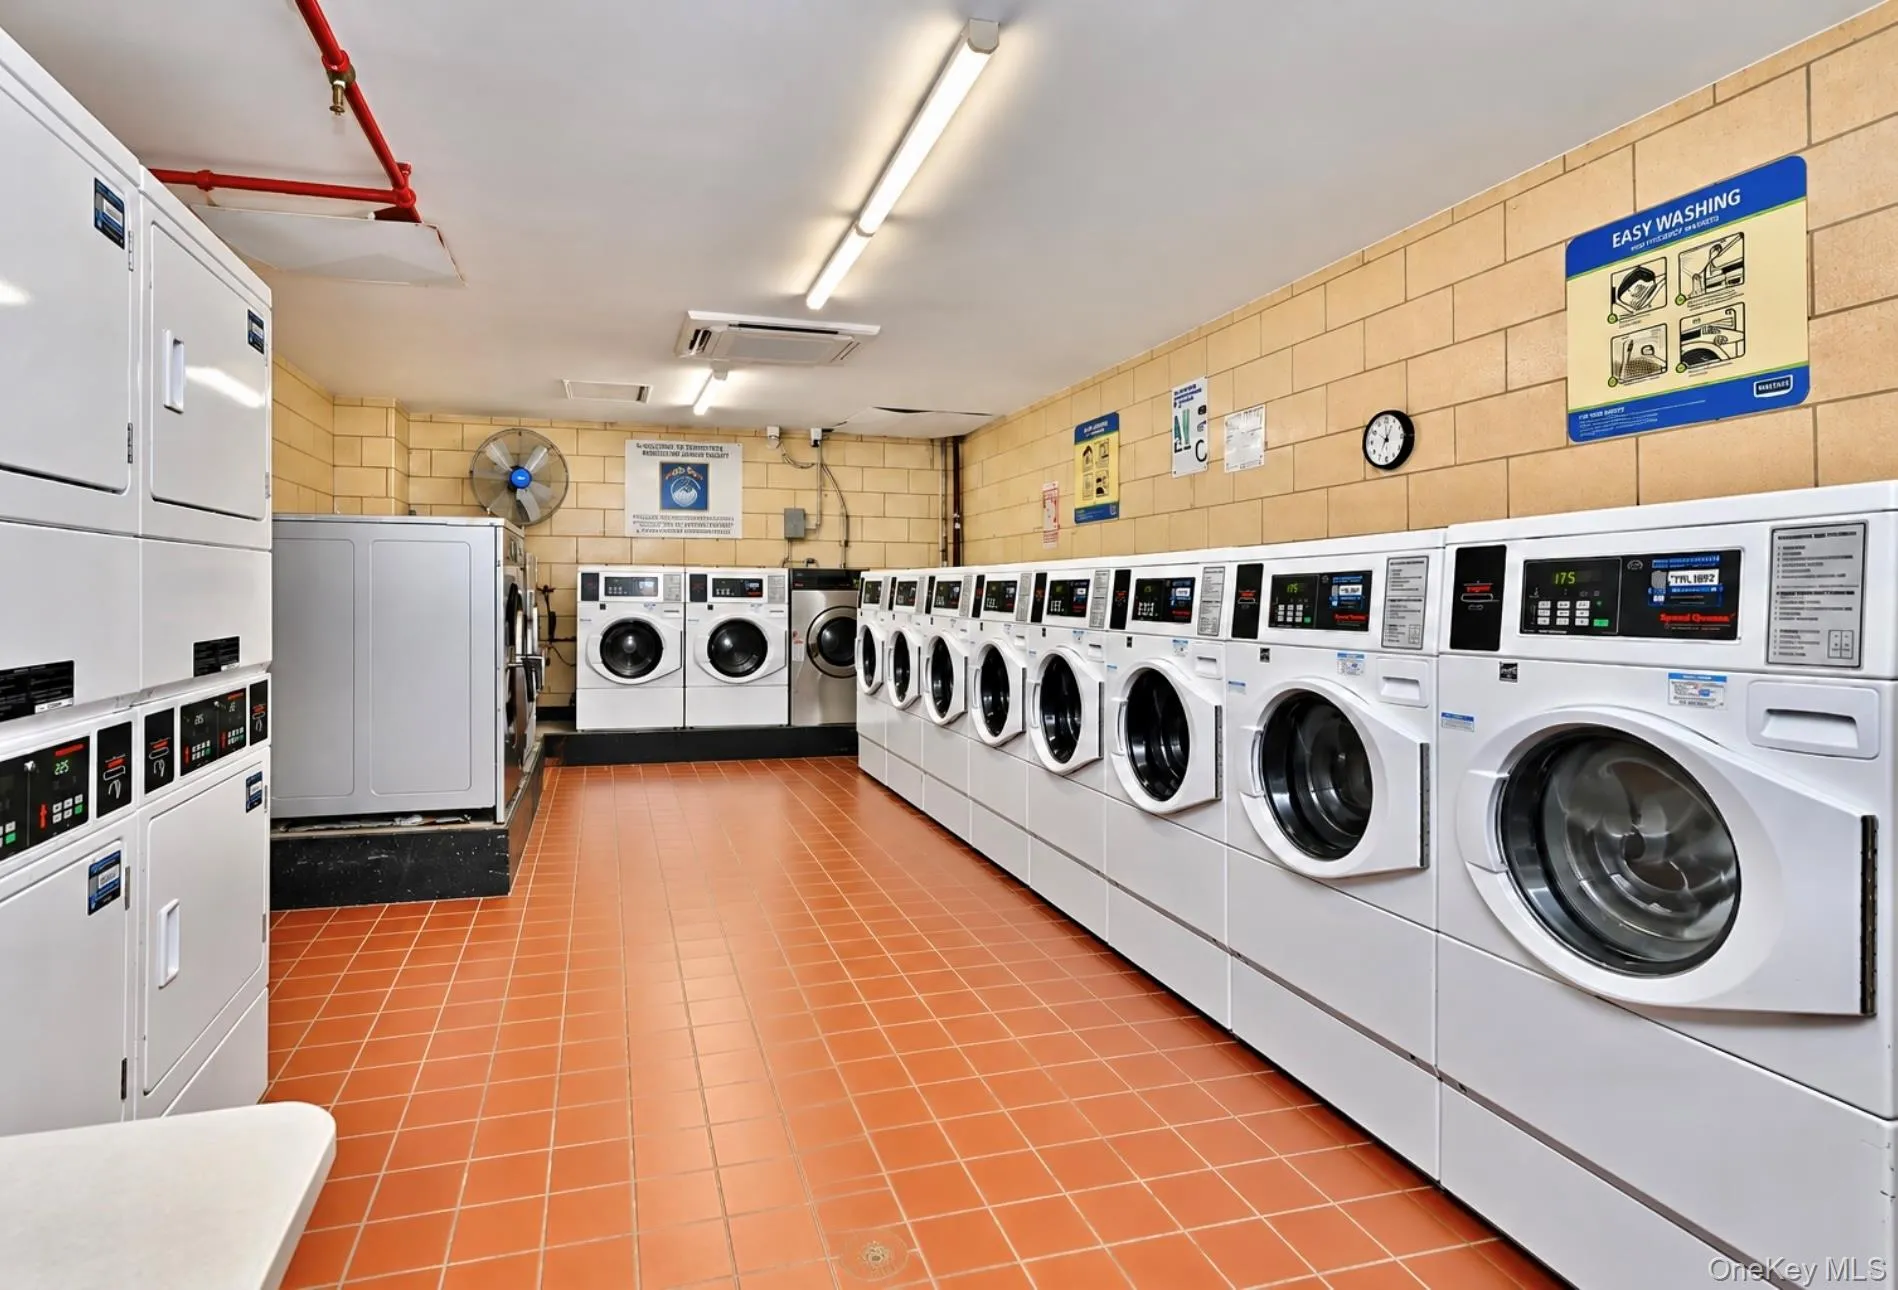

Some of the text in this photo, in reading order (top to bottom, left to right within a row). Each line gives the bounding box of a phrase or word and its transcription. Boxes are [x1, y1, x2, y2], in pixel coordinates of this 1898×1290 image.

[1612, 220, 1652, 249] EASY
[1656, 188, 1741, 232] WASHING
[1554, 571, 1576, 585] 175
